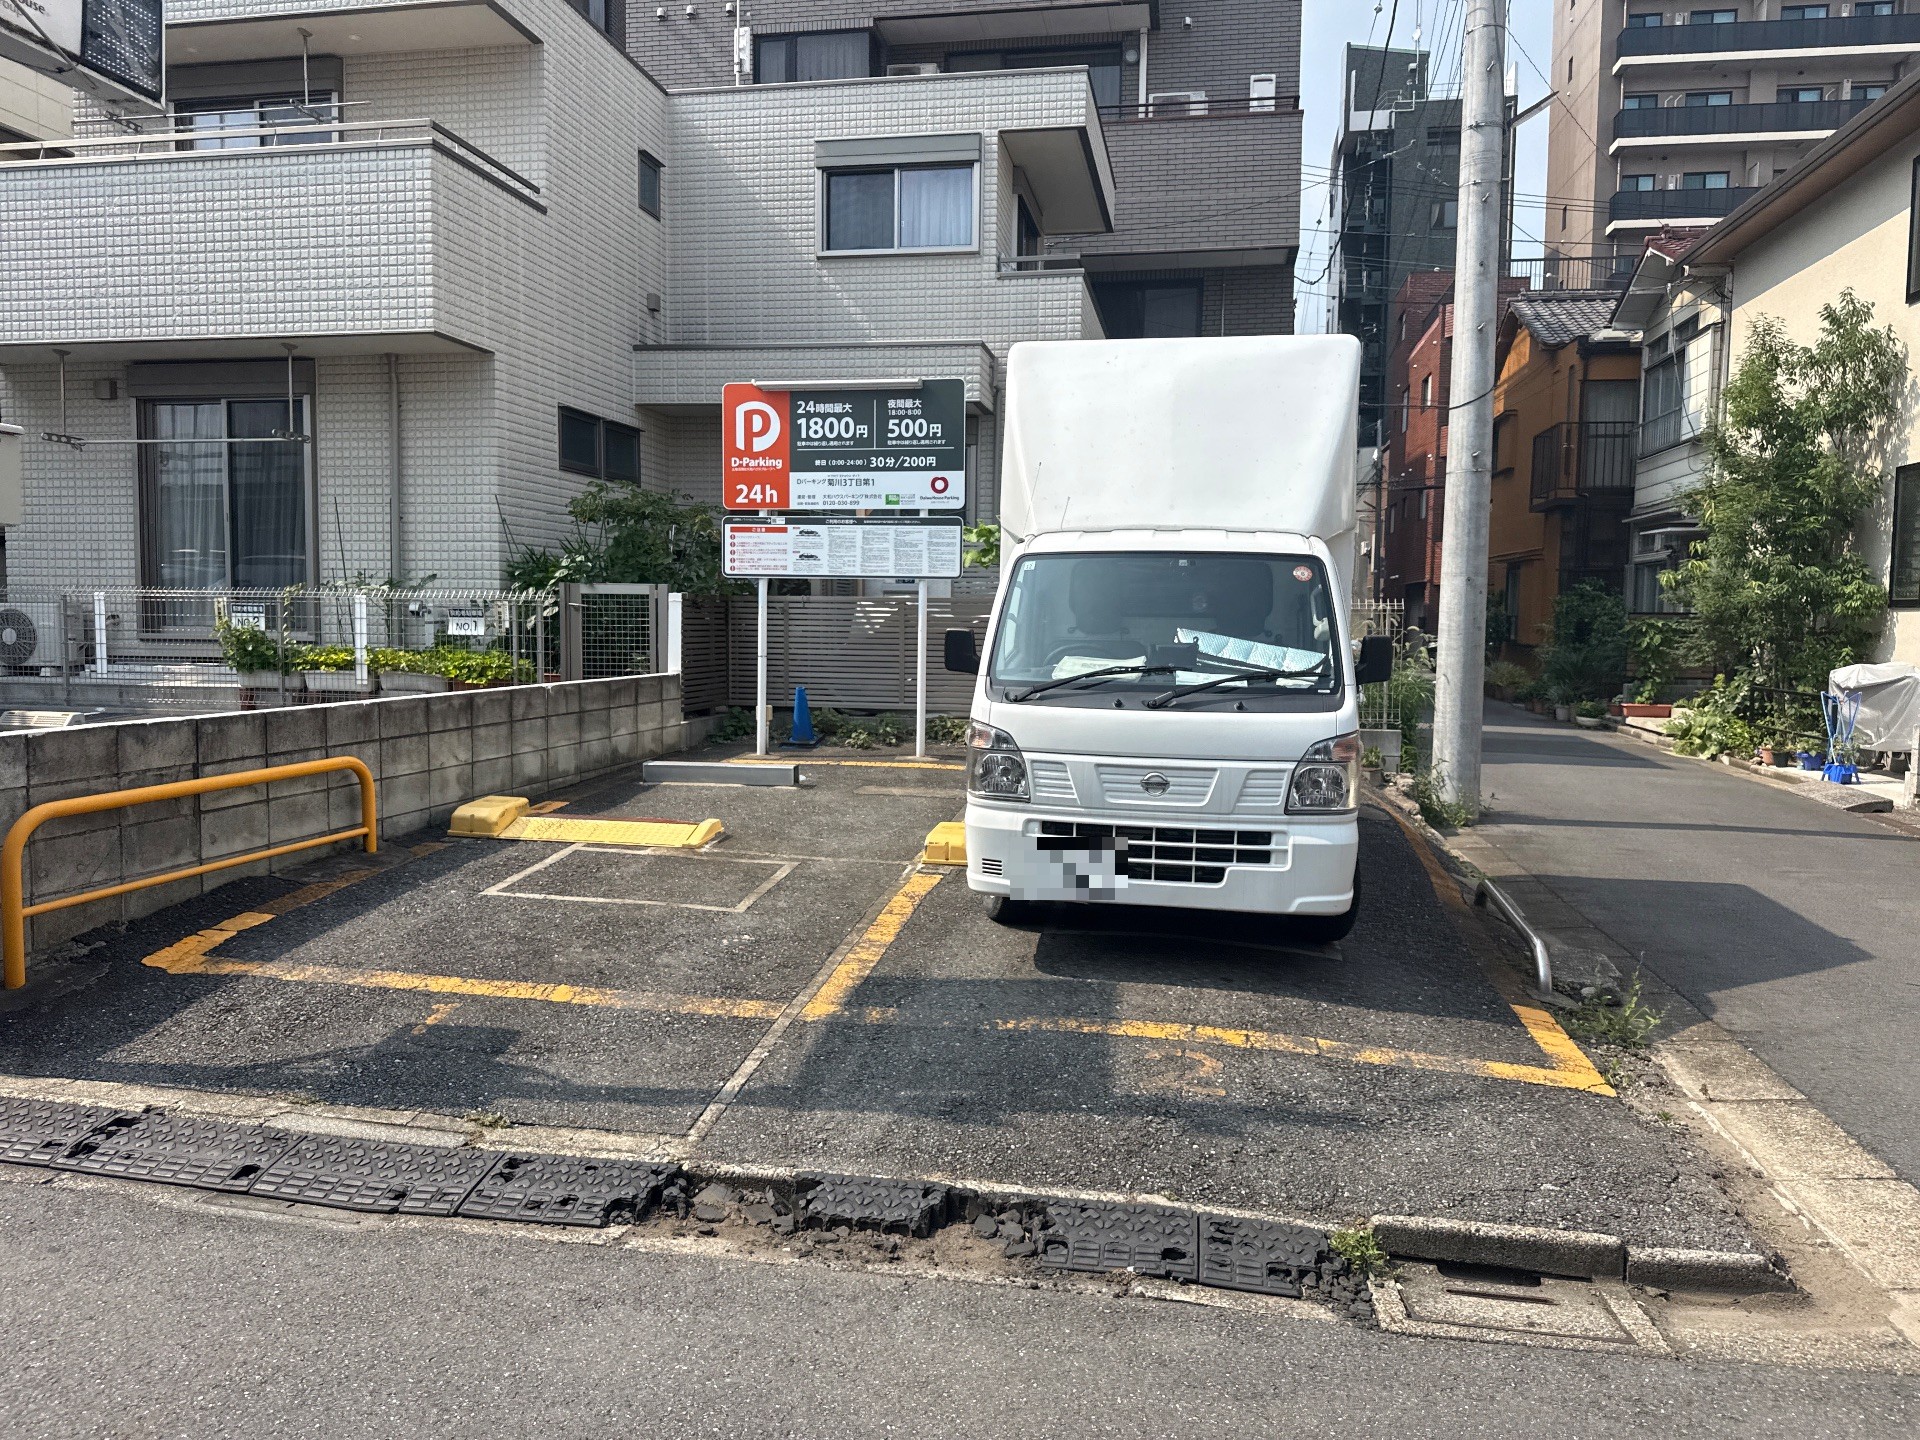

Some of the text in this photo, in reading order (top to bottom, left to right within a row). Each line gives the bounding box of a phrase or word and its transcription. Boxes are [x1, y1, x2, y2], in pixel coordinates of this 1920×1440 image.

[797, 401, 853, 414] 24時間最大
[887, 399, 922, 409] 夜間最大
[797, 416, 868, 439] 1800円
[887, 418, 942, 438] 500円
[869, 455, 936, 468] 30分/200円
[827, 478, 875, 487] 菊川3丁目第1
[735, 484, 778, 504] 24h
[455, 620, 478, 631] NO.1
